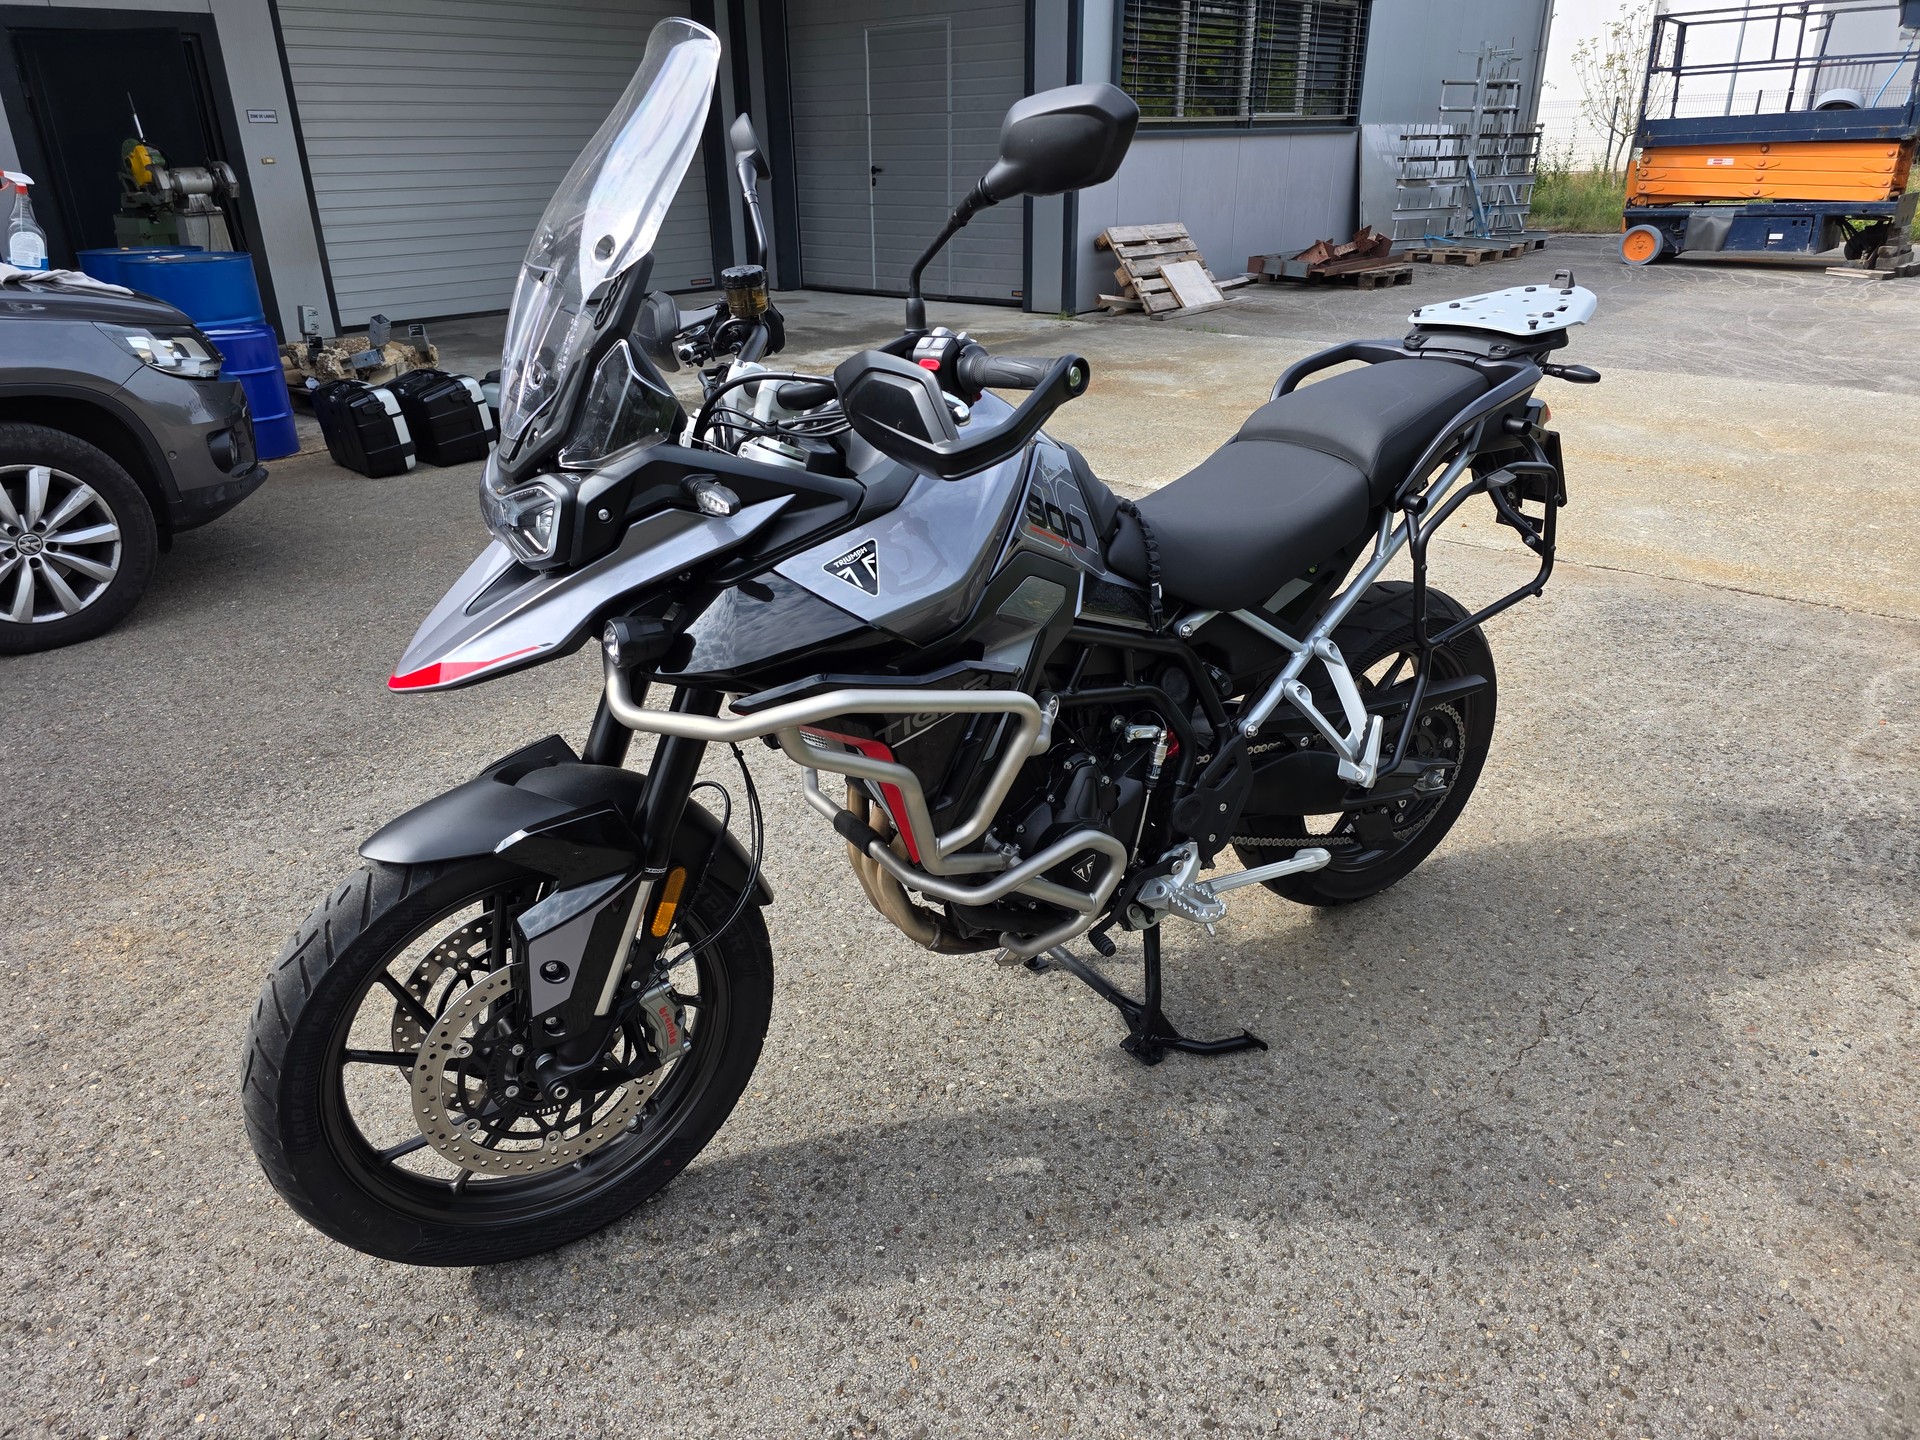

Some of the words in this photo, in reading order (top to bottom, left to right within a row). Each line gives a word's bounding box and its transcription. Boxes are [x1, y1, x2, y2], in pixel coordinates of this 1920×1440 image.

[1026, 491, 1087, 549] 900
[832, 546, 868, 568] TRIUMPH
[658, 1004, 677, 1045] brembo
